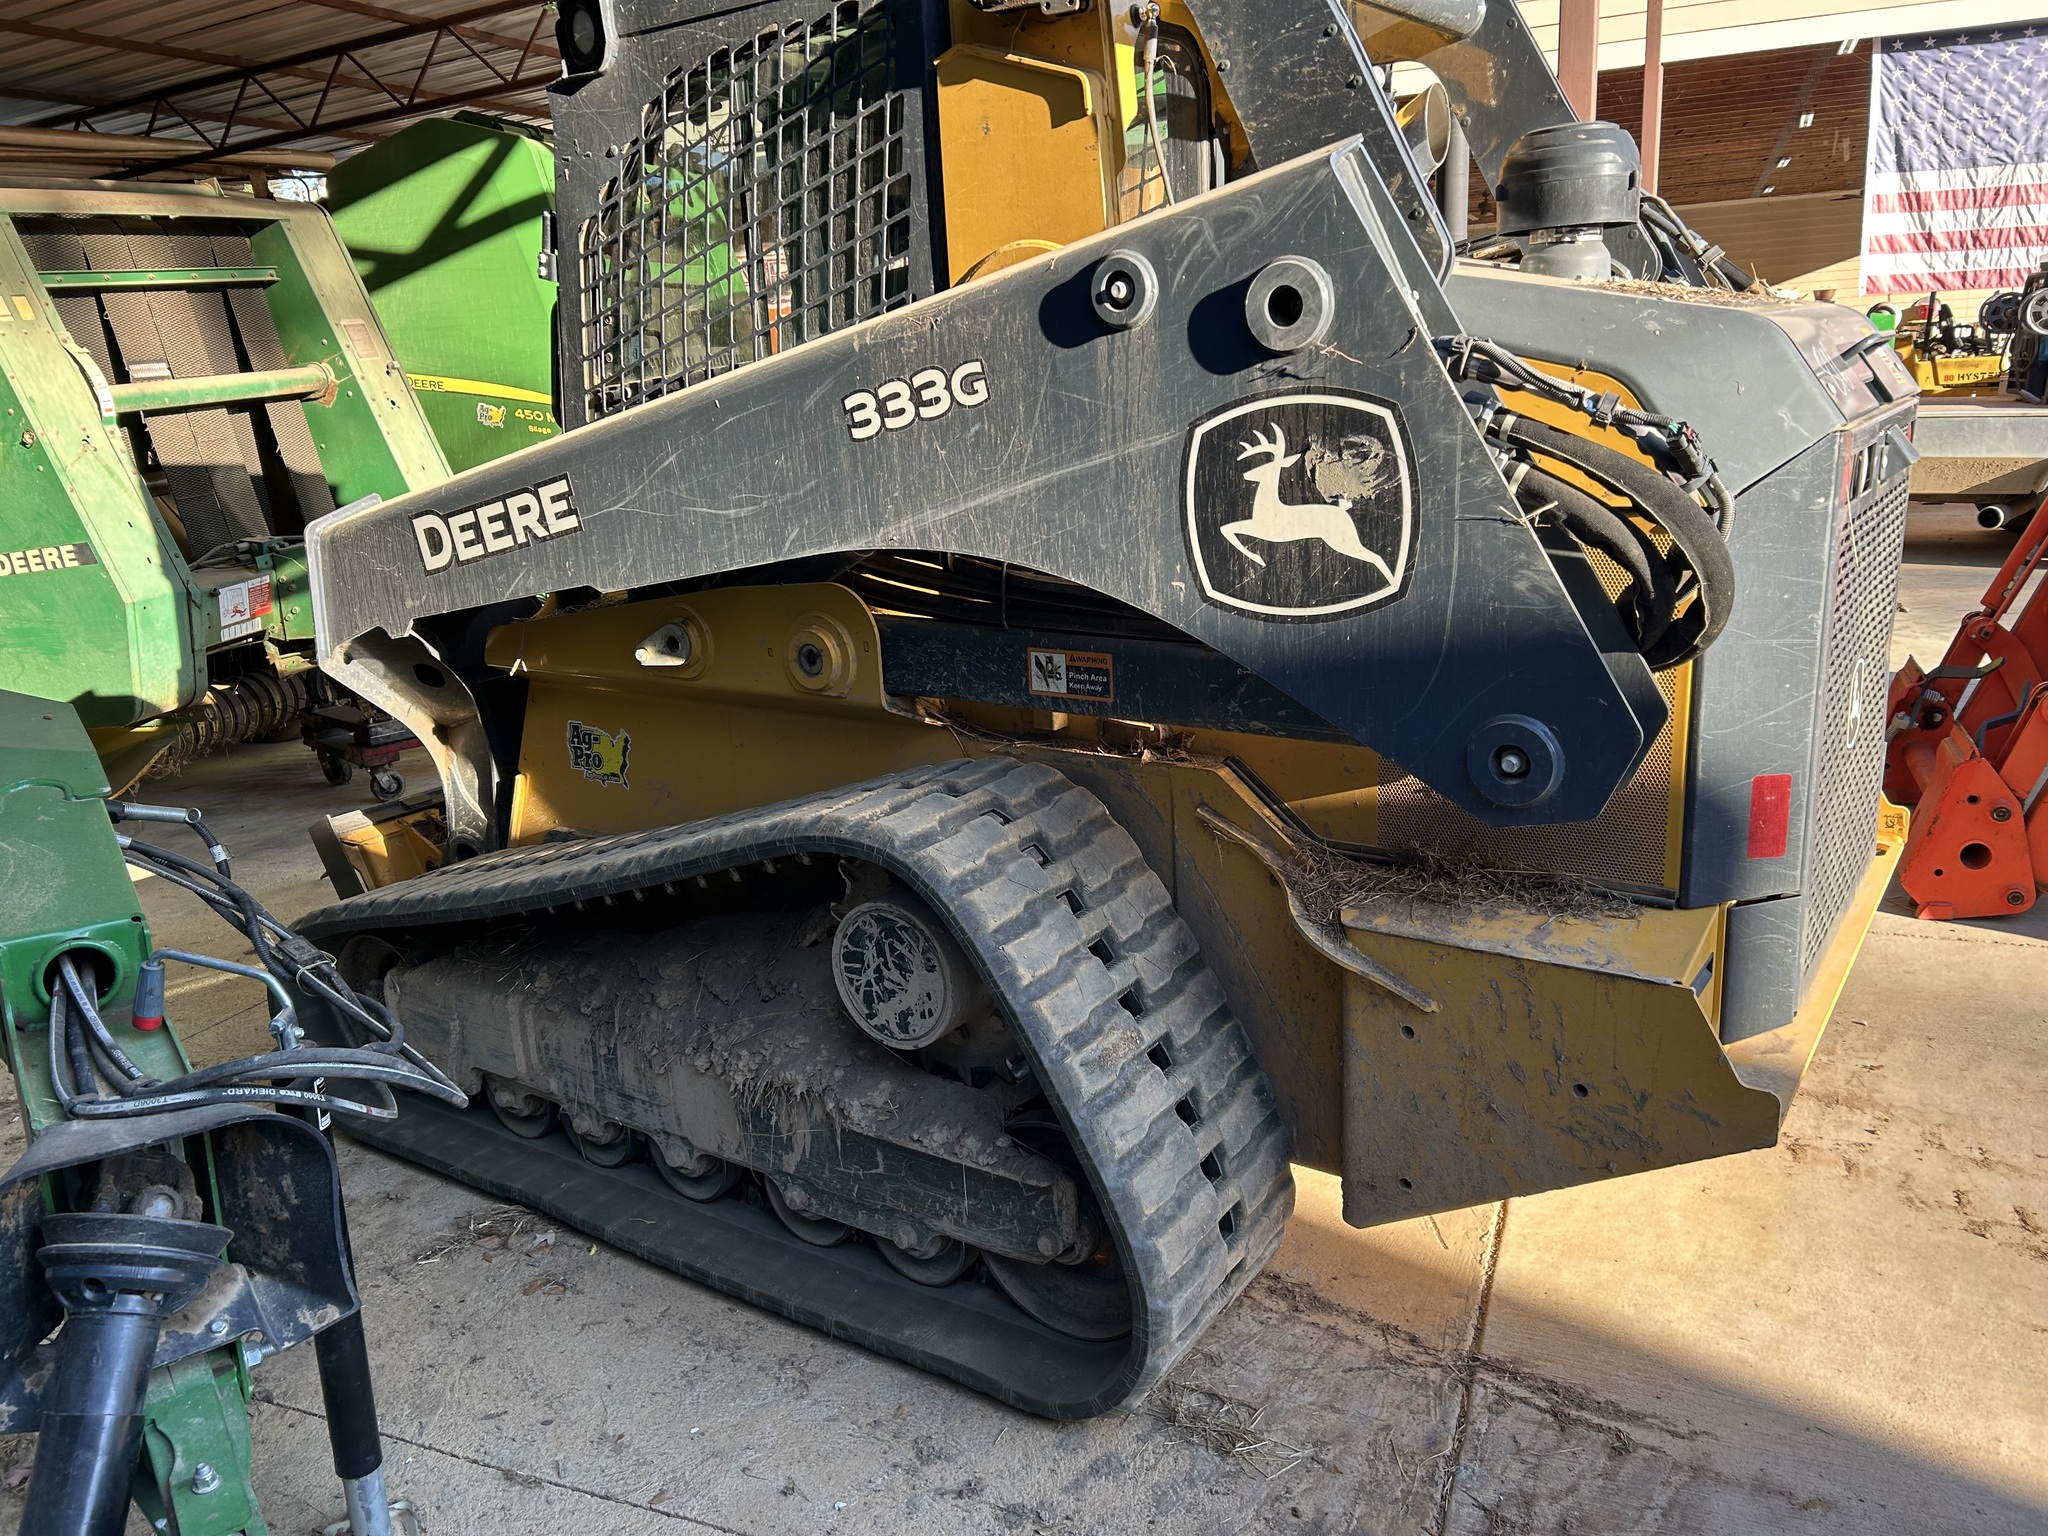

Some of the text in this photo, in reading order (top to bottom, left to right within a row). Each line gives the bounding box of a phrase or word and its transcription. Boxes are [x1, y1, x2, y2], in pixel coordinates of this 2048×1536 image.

[1944, 374, 1954, 382] 80
[843, 360, 989, 440] 333G
[515, 408, 544, 421] 450
[528, 425, 552, 434] Silage
[412, 479, 579, 571] DEERE
[1075, 655, 1108, 665] WARNING
[1069, 671, 1108, 682] Pinch Area
[1069, 682, 1102, 692] Keep Away
[570, 724, 600, 752] Ag-
[572, 746, 604, 770] Pro
[133, 1096, 169, 1108] T3006D
[303, 1091, 326, 1102] T3000
